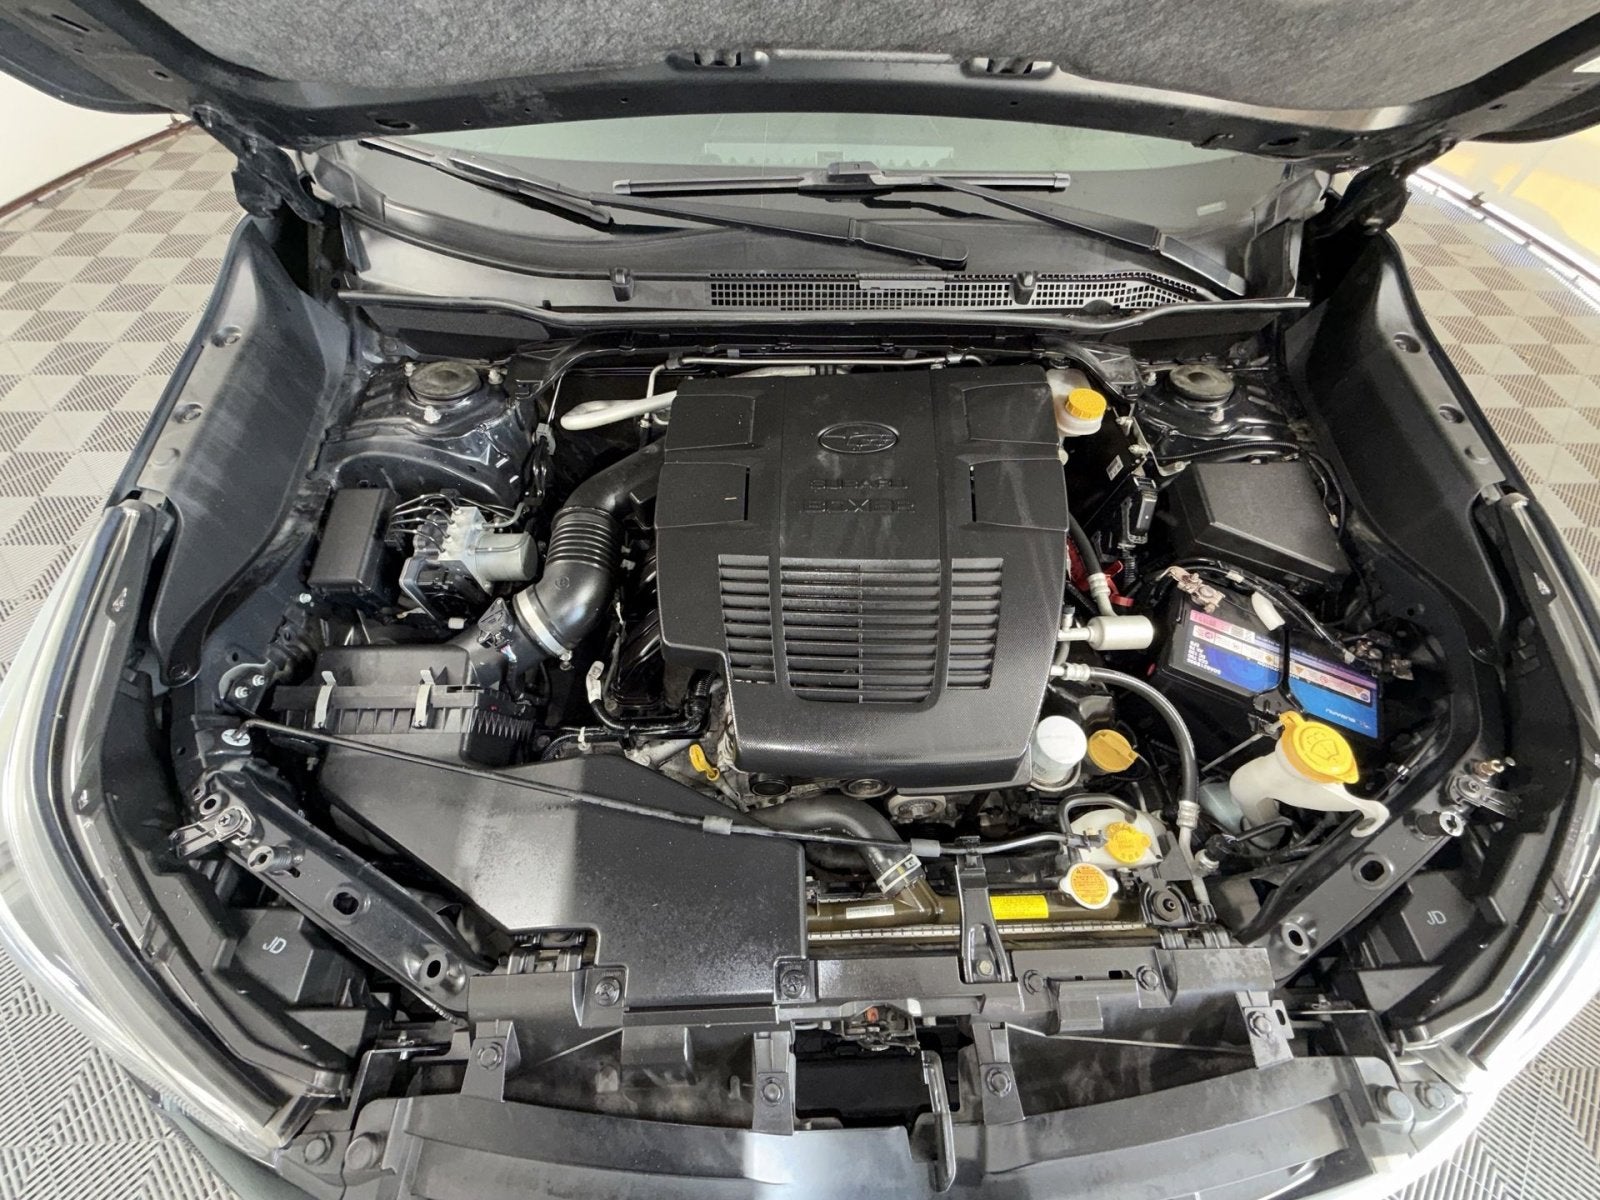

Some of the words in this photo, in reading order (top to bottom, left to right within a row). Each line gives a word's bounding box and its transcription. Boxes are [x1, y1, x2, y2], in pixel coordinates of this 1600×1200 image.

[799, 498, 916, 513] BOXER
[1426, 910, 1447, 926] JD
[262, 936, 287, 954] JD
